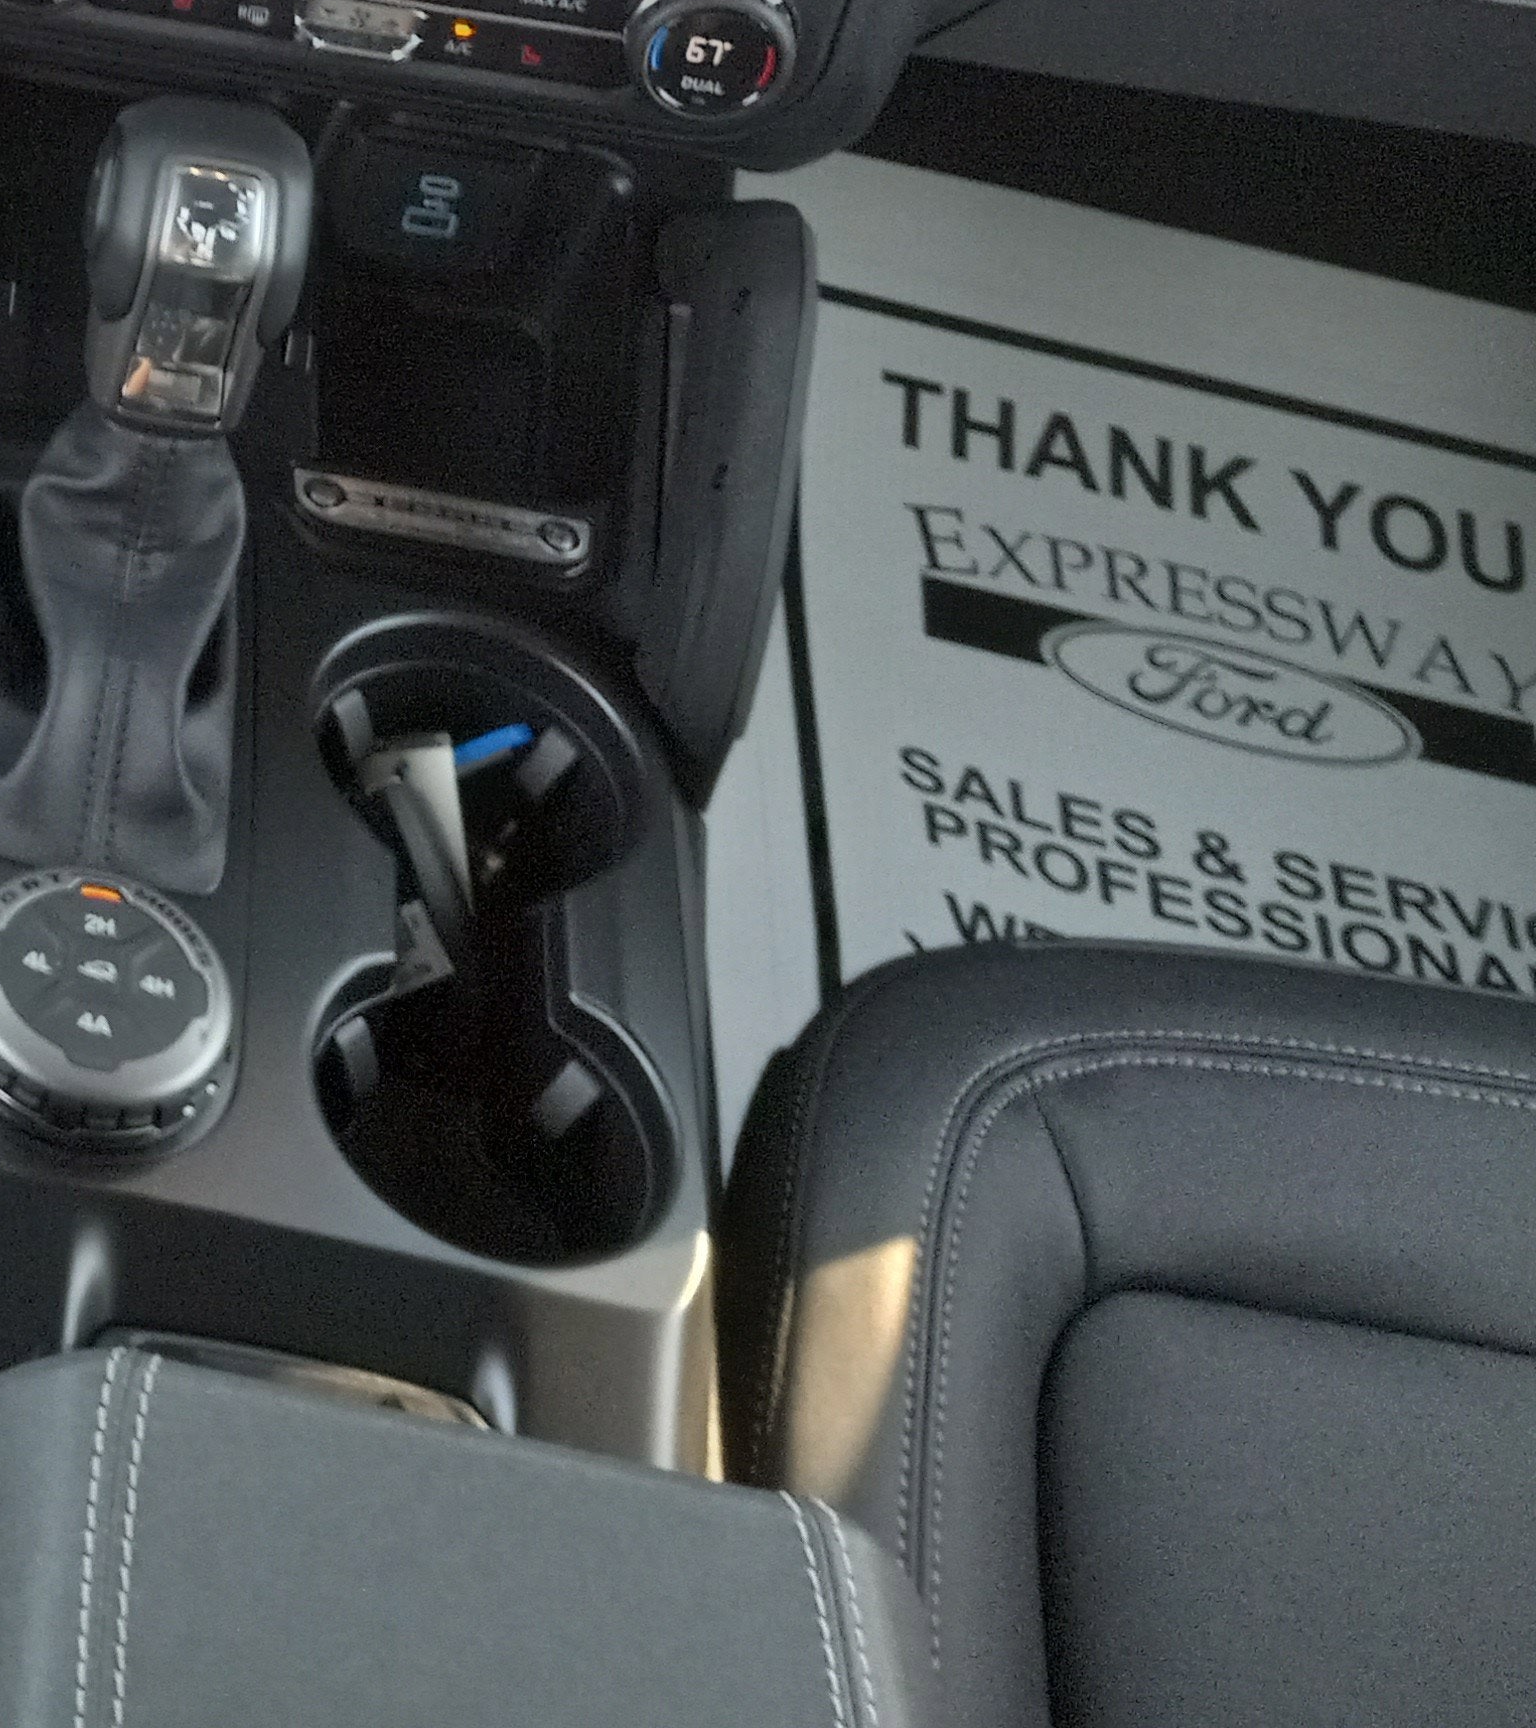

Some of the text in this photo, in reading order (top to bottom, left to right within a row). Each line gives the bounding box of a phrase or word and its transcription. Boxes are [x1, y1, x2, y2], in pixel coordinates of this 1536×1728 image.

[680, 74, 726, 97] DUAL
[880, 369, 1526, 593] THANK YOU
[903, 502, 1536, 713] EXPRESSWAY
[1127, 641, 1334, 747] Ford
[898, 745, 1536, 959] SALES & SERVI
[922, 799, 1536, 994] PROFESSIONA
